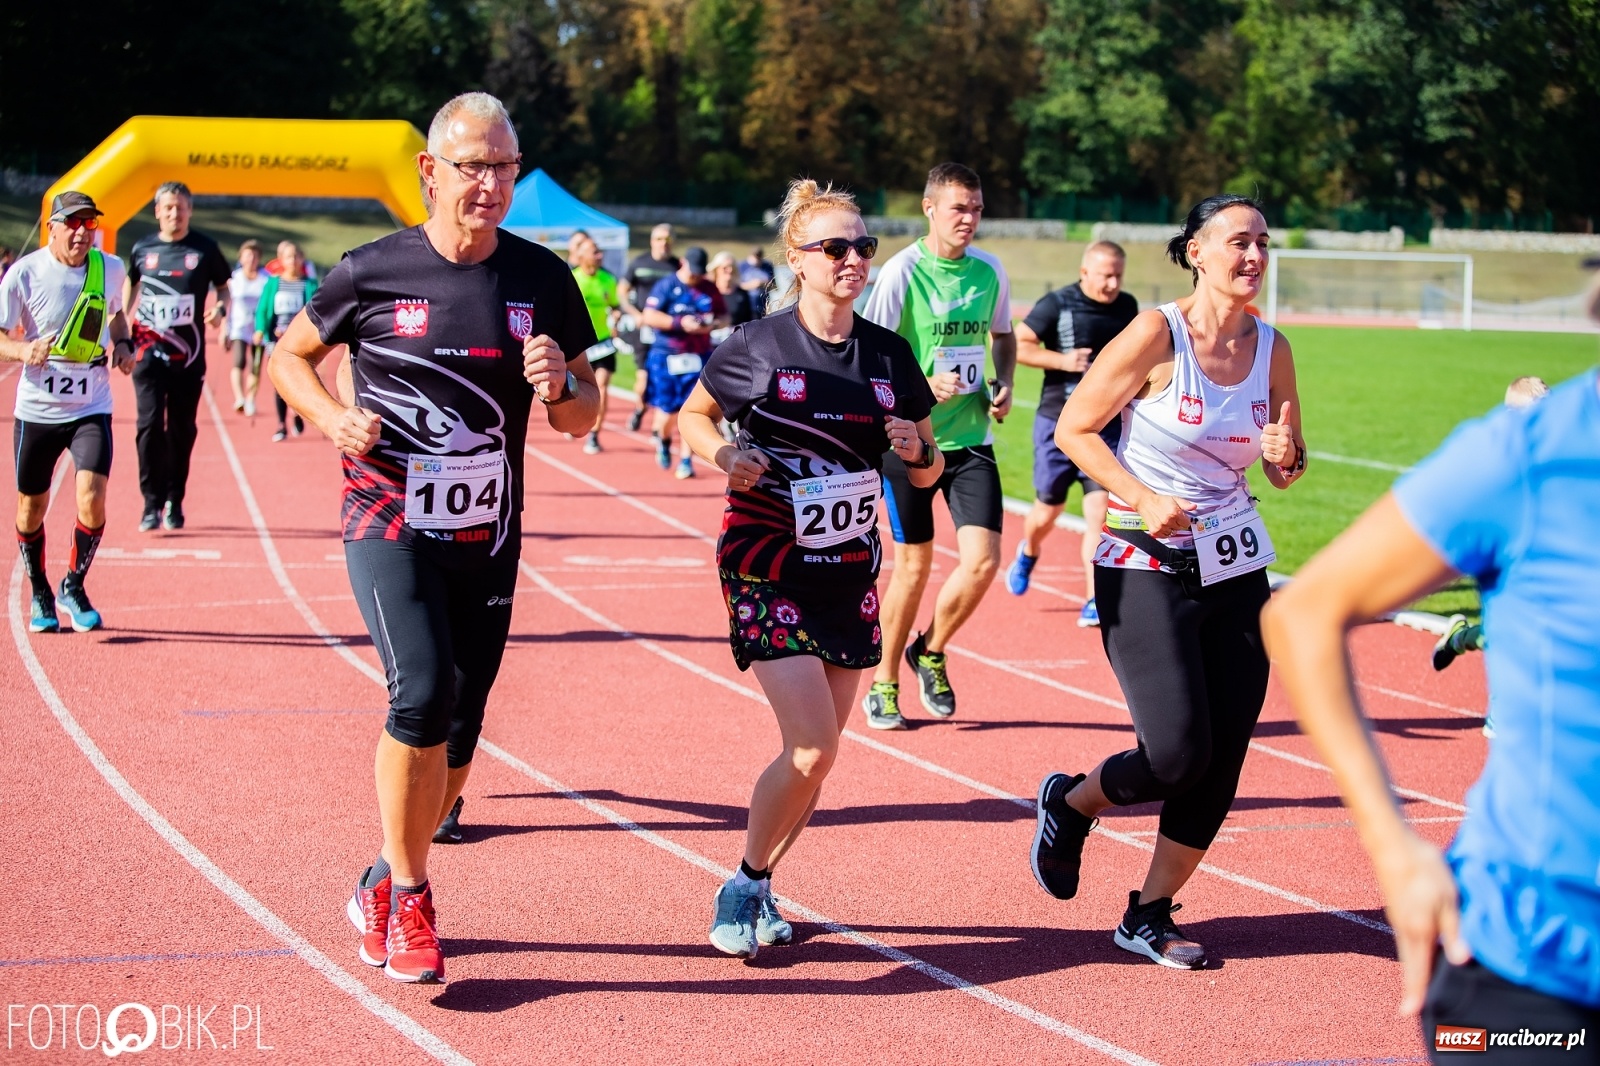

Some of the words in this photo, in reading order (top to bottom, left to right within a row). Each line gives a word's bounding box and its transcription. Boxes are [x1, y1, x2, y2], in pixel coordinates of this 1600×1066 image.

[188, 153, 254, 169] MIASTO
[259, 155, 348, 171] RACIBÓRZ
[159, 305, 191, 319] 194
[932, 322, 960, 336] JUST
[963, 321, 979, 335] DO
[44, 376, 87, 395] 121
[415, 478, 498, 515] 104
[802, 494, 876, 536] 205
[1215, 526, 1259, 566] 99
